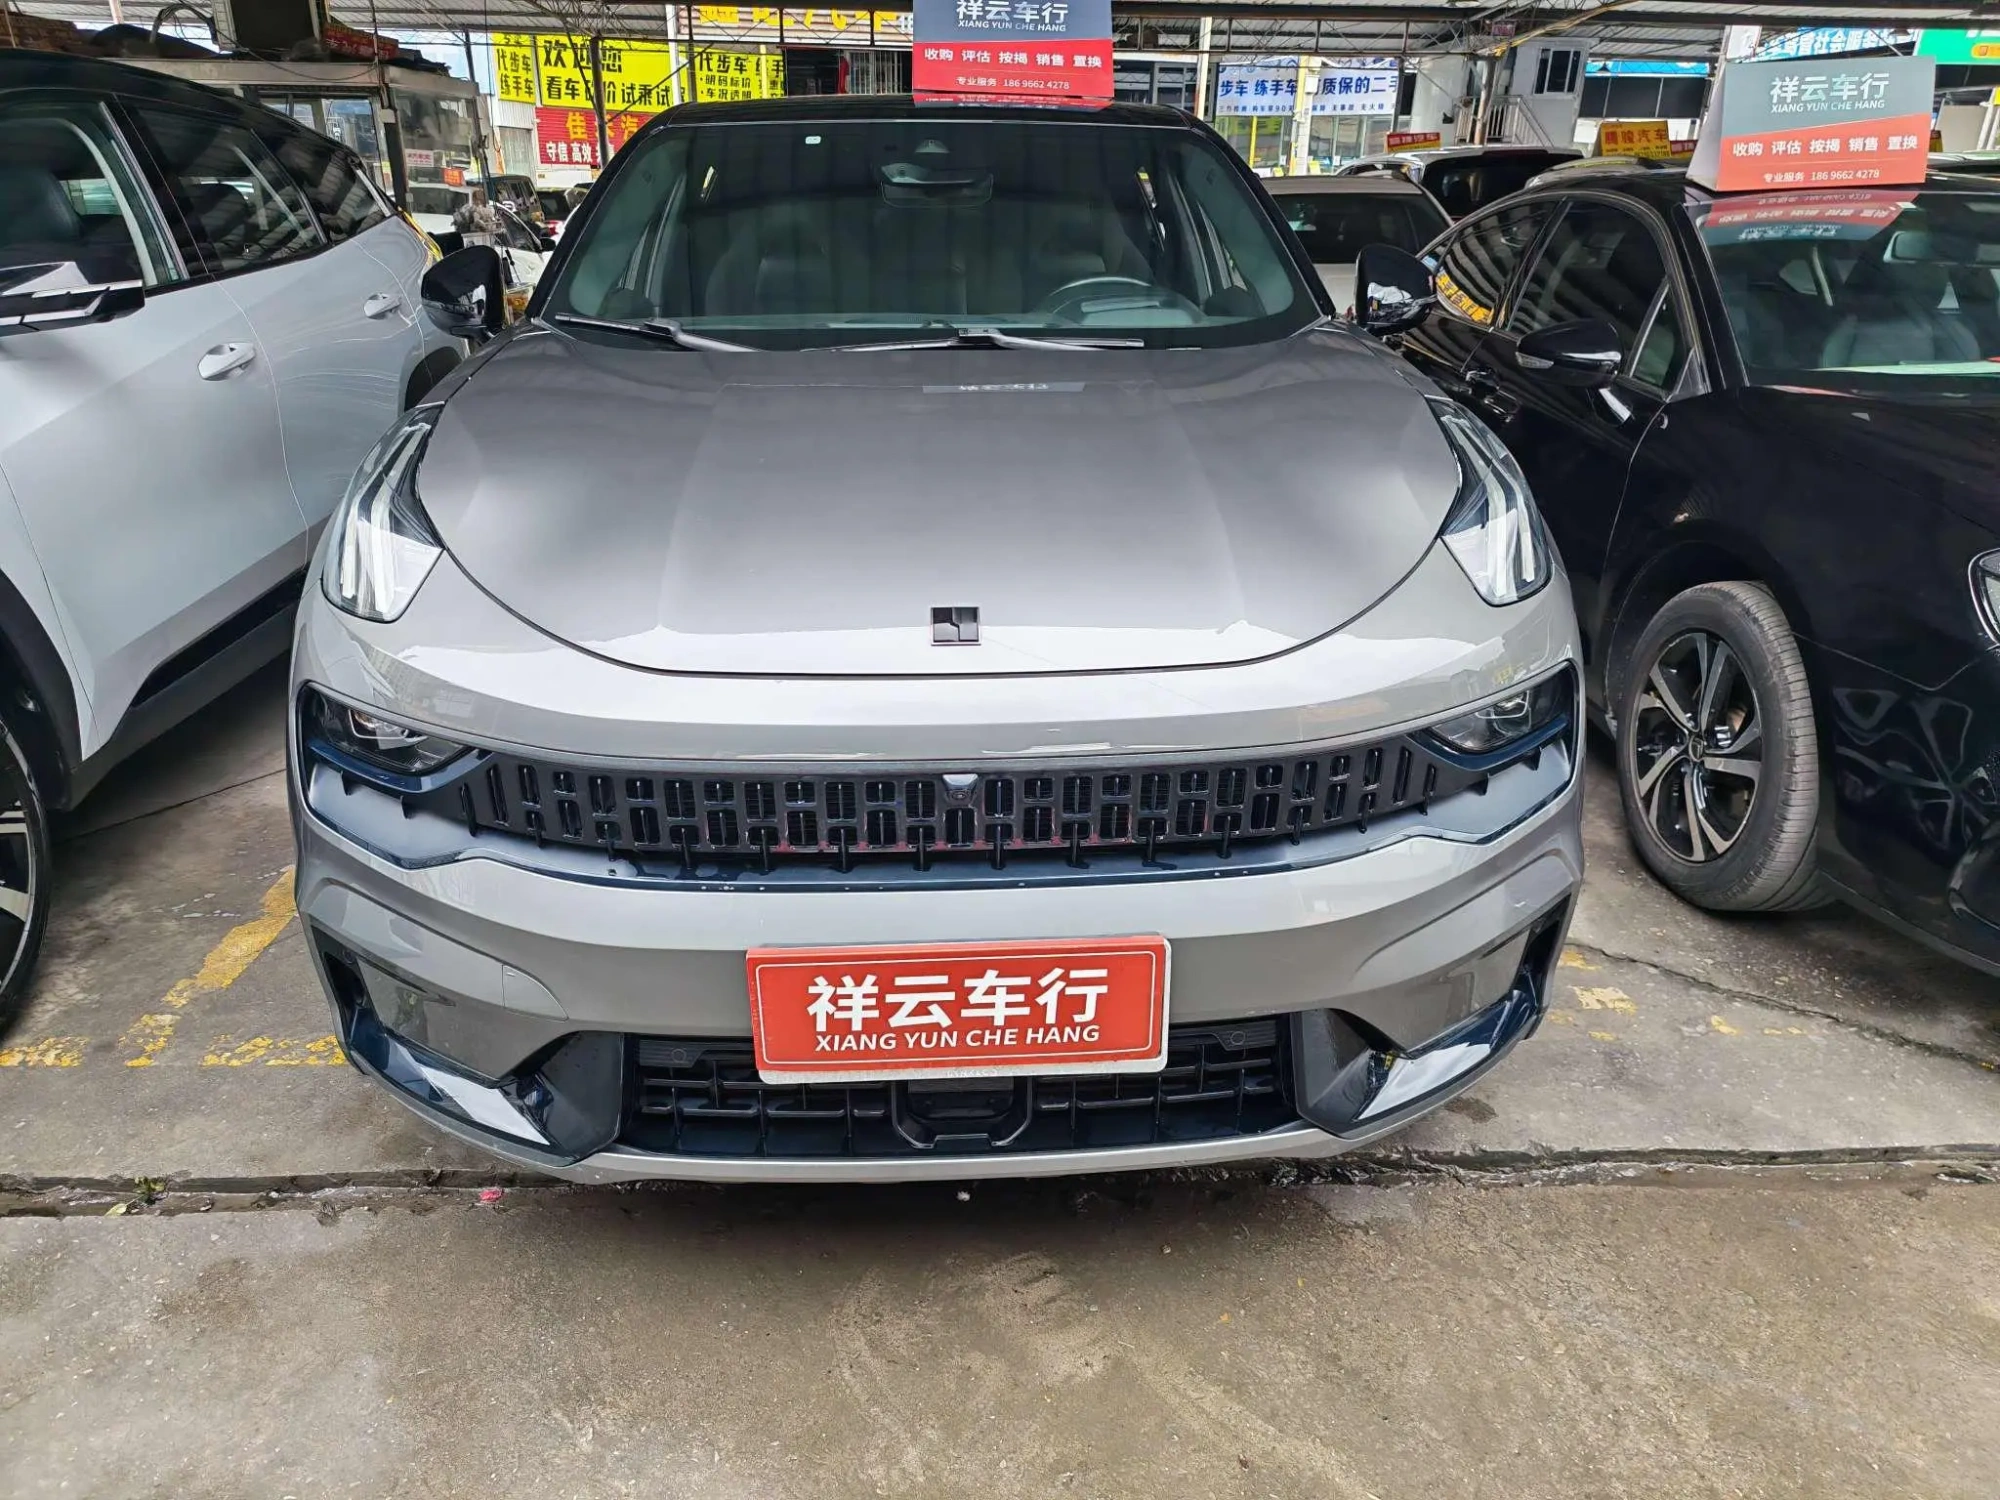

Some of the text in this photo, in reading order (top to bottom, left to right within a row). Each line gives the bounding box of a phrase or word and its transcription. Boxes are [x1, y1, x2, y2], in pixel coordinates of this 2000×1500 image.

[956, 0, 1069, 24] 祥云车行
[958, 20, 1066, 32] XIANG YUN CHE HANG
[497, 48, 531, 74] 代步车
[699, 53, 747, 74] 代步车
[924, 48, 1102, 68] 收购 评估 按揭 销售 置换
[500, 73, 534, 98] 练手车
[956, 76, 1070, 90] 专业服务 186 9662 4278
[1254, 79, 1298, 97] 练手车
[1769, 72, 1890, 103] 祥云车行
[1771, 100, 1885, 114] XIANG YUN CHE HANG
[1732, 135, 1917, 157] 收购 评估 按揭 销售 置换
[1763, 170, 1880, 183] 专业服务 186 9662 4278
[807, 968, 1108, 1031] 祥云车行
[815, 1025, 1100, 1052] XIANG YUN CHE HANG
